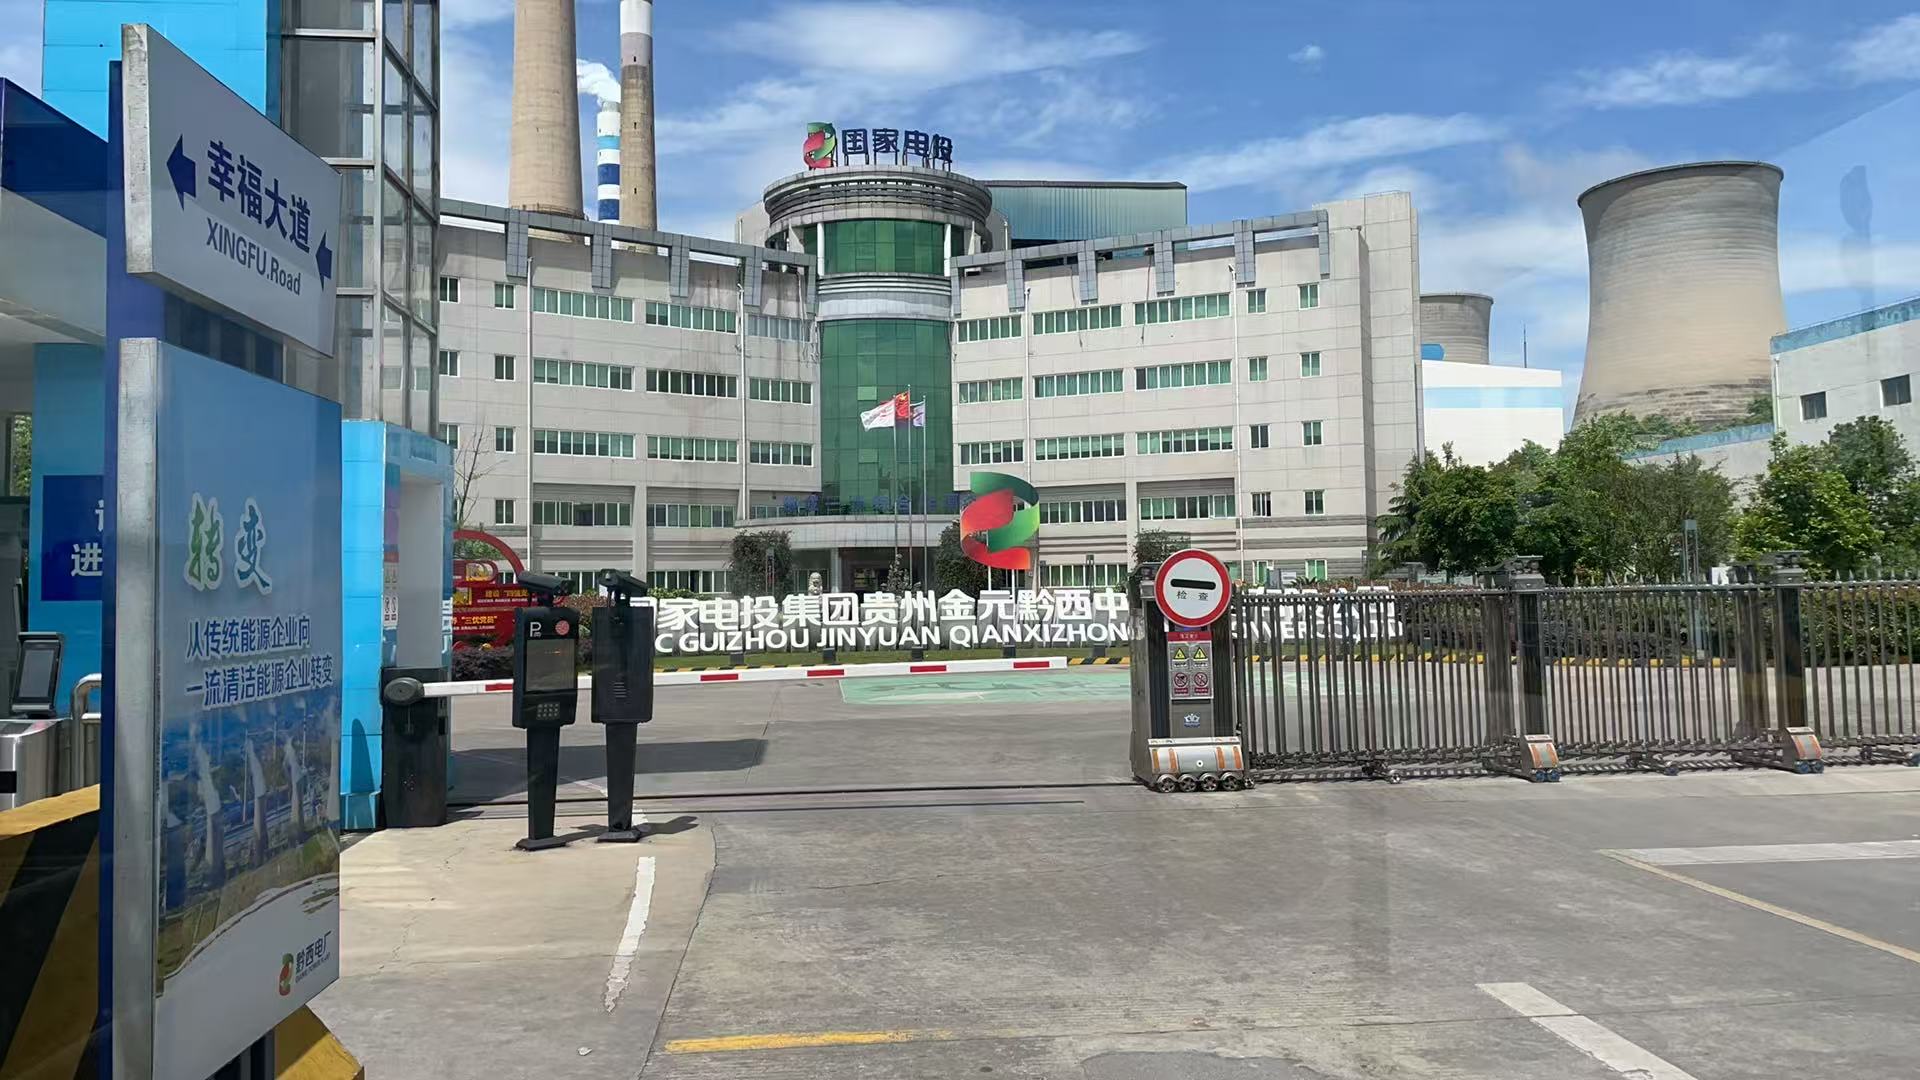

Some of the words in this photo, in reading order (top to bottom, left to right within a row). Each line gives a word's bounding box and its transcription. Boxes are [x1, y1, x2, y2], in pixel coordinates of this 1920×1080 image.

[842, 128, 953, 163] 国家电投
[207, 140, 311, 254] 幸福大道
[206, 218, 301, 296] XINGFU.Road
[1177, 590, 1208, 600] 检查
[186, 615, 311, 659] 从传统能源企业向
[679, 629, 809, 652] GUIZHOU
[816, 624, 941, 647] JINYUAN
[949, 621, 1131, 648] QIANXIZHON
[186, 655, 333, 706] 一流清洁能源企业转变
[296, 930, 332, 974] 黔西电厂
